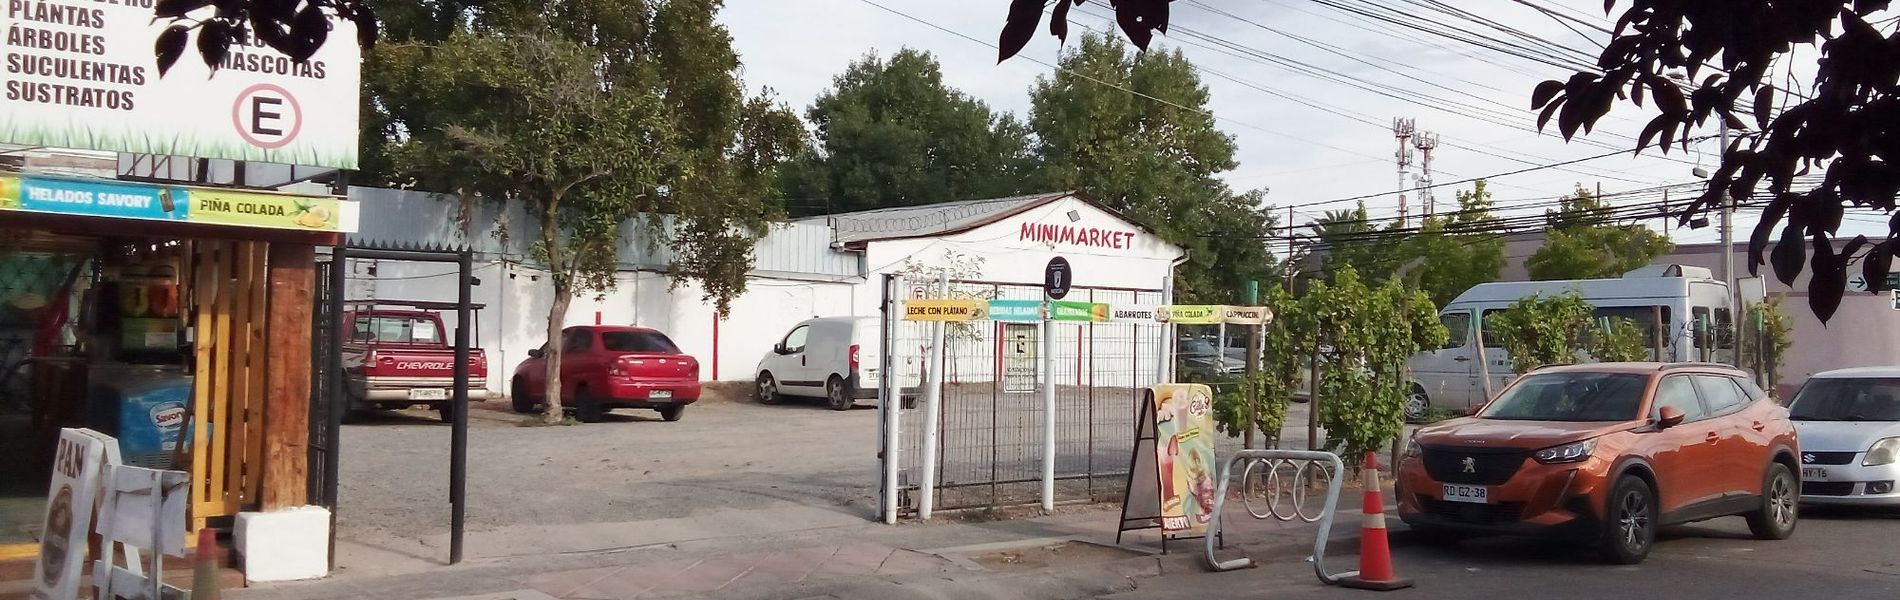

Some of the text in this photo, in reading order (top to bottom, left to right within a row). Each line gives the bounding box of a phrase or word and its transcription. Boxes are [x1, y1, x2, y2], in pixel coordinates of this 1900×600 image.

[7, 22, 105, 55] ÁRBOLES
[7, 52, 145, 86] SUCULENTAS
[6, 80, 134, 111] SUSTRATOS
[252, 96, 283, 136] E
[28, 186, 153, 209] HELADOS SAVORY
[199, 198, 285, 217] PIÑA COLADA
[1020, 222, 1135, 250] MINIMARKET
[907, 306, 926, 315] LECHE
[928, 306, 942, 315] CON
[1114, 310, 1152, 319] ABARROTES
[1184, 310, 1203, 318] COLADA
[396, 361, 454, 370] CHEVROLE
[156, 411, 184, 424] Savor
[57, 438, 85, 479] PAN
[1444, 486, 1456, 496] RD
